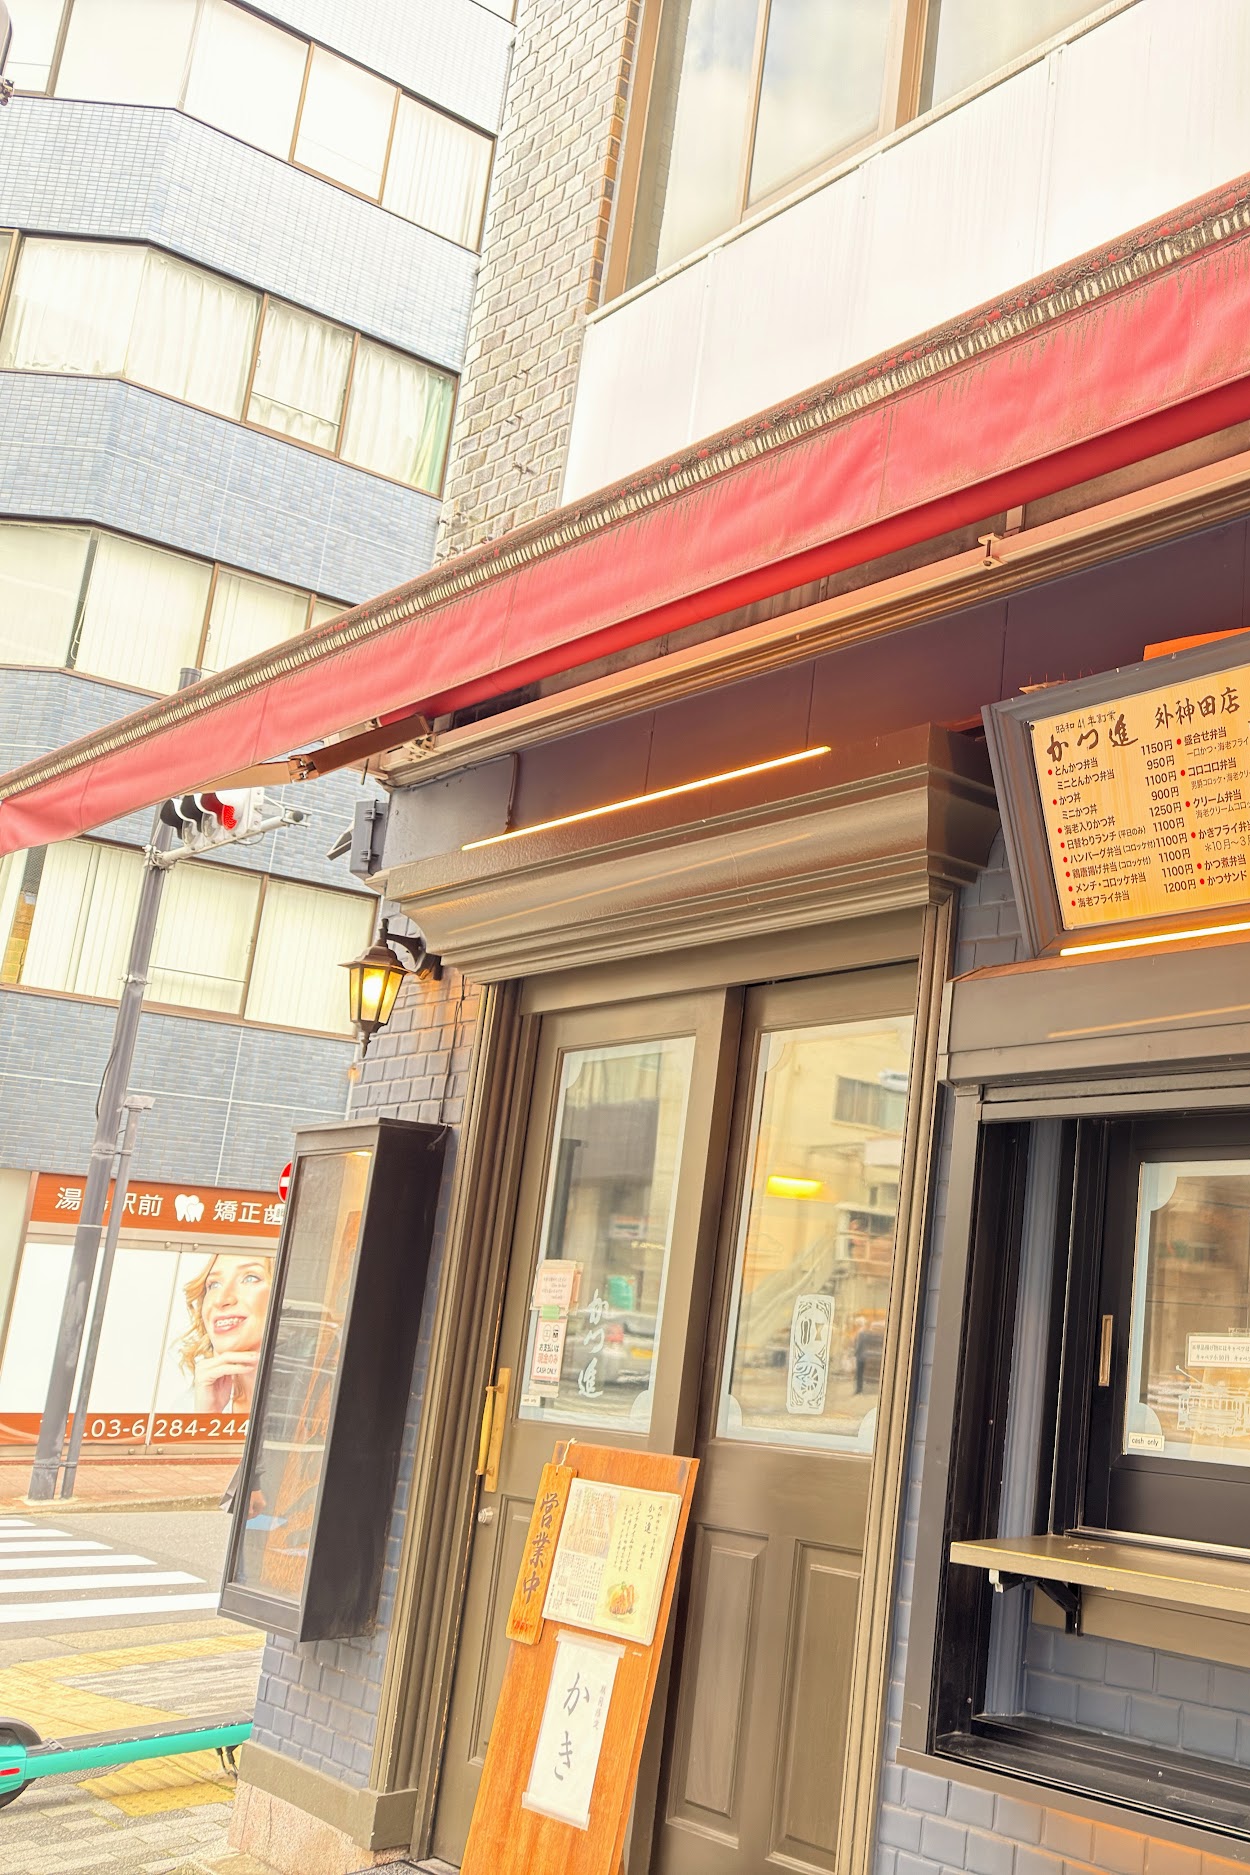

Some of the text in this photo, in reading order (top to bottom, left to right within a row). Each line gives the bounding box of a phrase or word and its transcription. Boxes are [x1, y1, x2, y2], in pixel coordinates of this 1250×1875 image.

[1046, 686, 1241, 762] かつ進 外神田店
[1184, 726, 1227, 747] 盛合せ弁当
[1055, 739, 1173, 776] とんかつ弁当 1150円
[1057, 755, 1175, 790] ミニとんかつ弁当 950円
[1188, 756, 1237, 777] コロコロ弁当
[1059, 770, 1177, 806] かつ丼 1100円
[1062, 786, 1179, 820] ミニかつ丼 900円
[1193, 788, 1242, 809] クリーム弁当
[1064, 801, 1182, 835] 海老入りかつ丼 1250円
[1067, 830, 1117, 850] 日替わりランチ
[1153, 817, 1185, 832] 1100円
[1070, 845, 1122, 864] ハンバーグ弁当
[1156, 832, 1188, 848] 1100円
[1072, 861, 1118, 880] 鶏唐揚げ弁当
[1159, 848, 1191, 863] 1100円
[1204, 854, 1247, 871] かつ煮弁当
[1161, 863, 1194, 878] 1100円
[1207, 870, 1248, 887] かつサンド
[1078, 878, 1197, 908] 海老フライ弁当 1200円
[55, 1187, 283, 1226] 湯前 矯正歯
[522, 1492, 560, 1604] 営業中
[554, 1672, 590, 1781] かき
